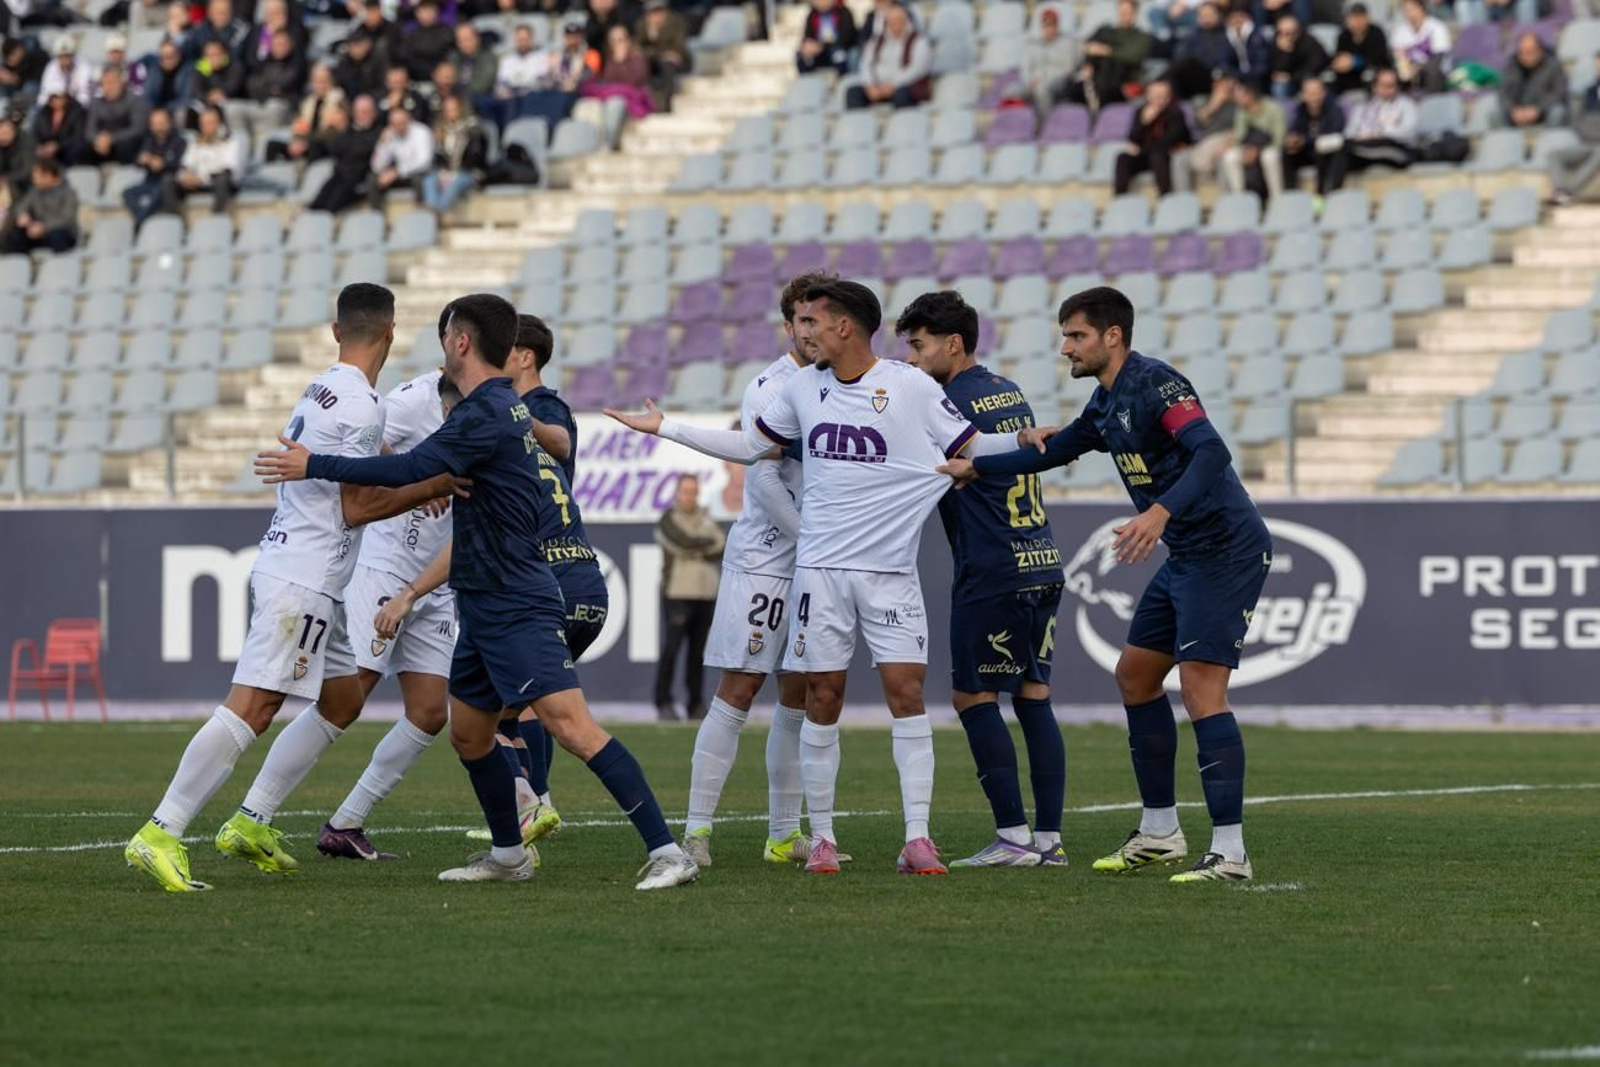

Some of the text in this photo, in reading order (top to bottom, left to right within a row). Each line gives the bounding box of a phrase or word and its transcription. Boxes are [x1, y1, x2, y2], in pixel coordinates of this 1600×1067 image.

[971, 390, 1025, 414] HEREDIA
[1420, 555, 1600, 597] PROT
[748, 592, 785, 631] 20
[798, 592, 811, 628] 4
[1243, 582, 1359, 658] seja
[1470, 608, 1600, 650] SEG
[299, 613, 327, 655] 17
